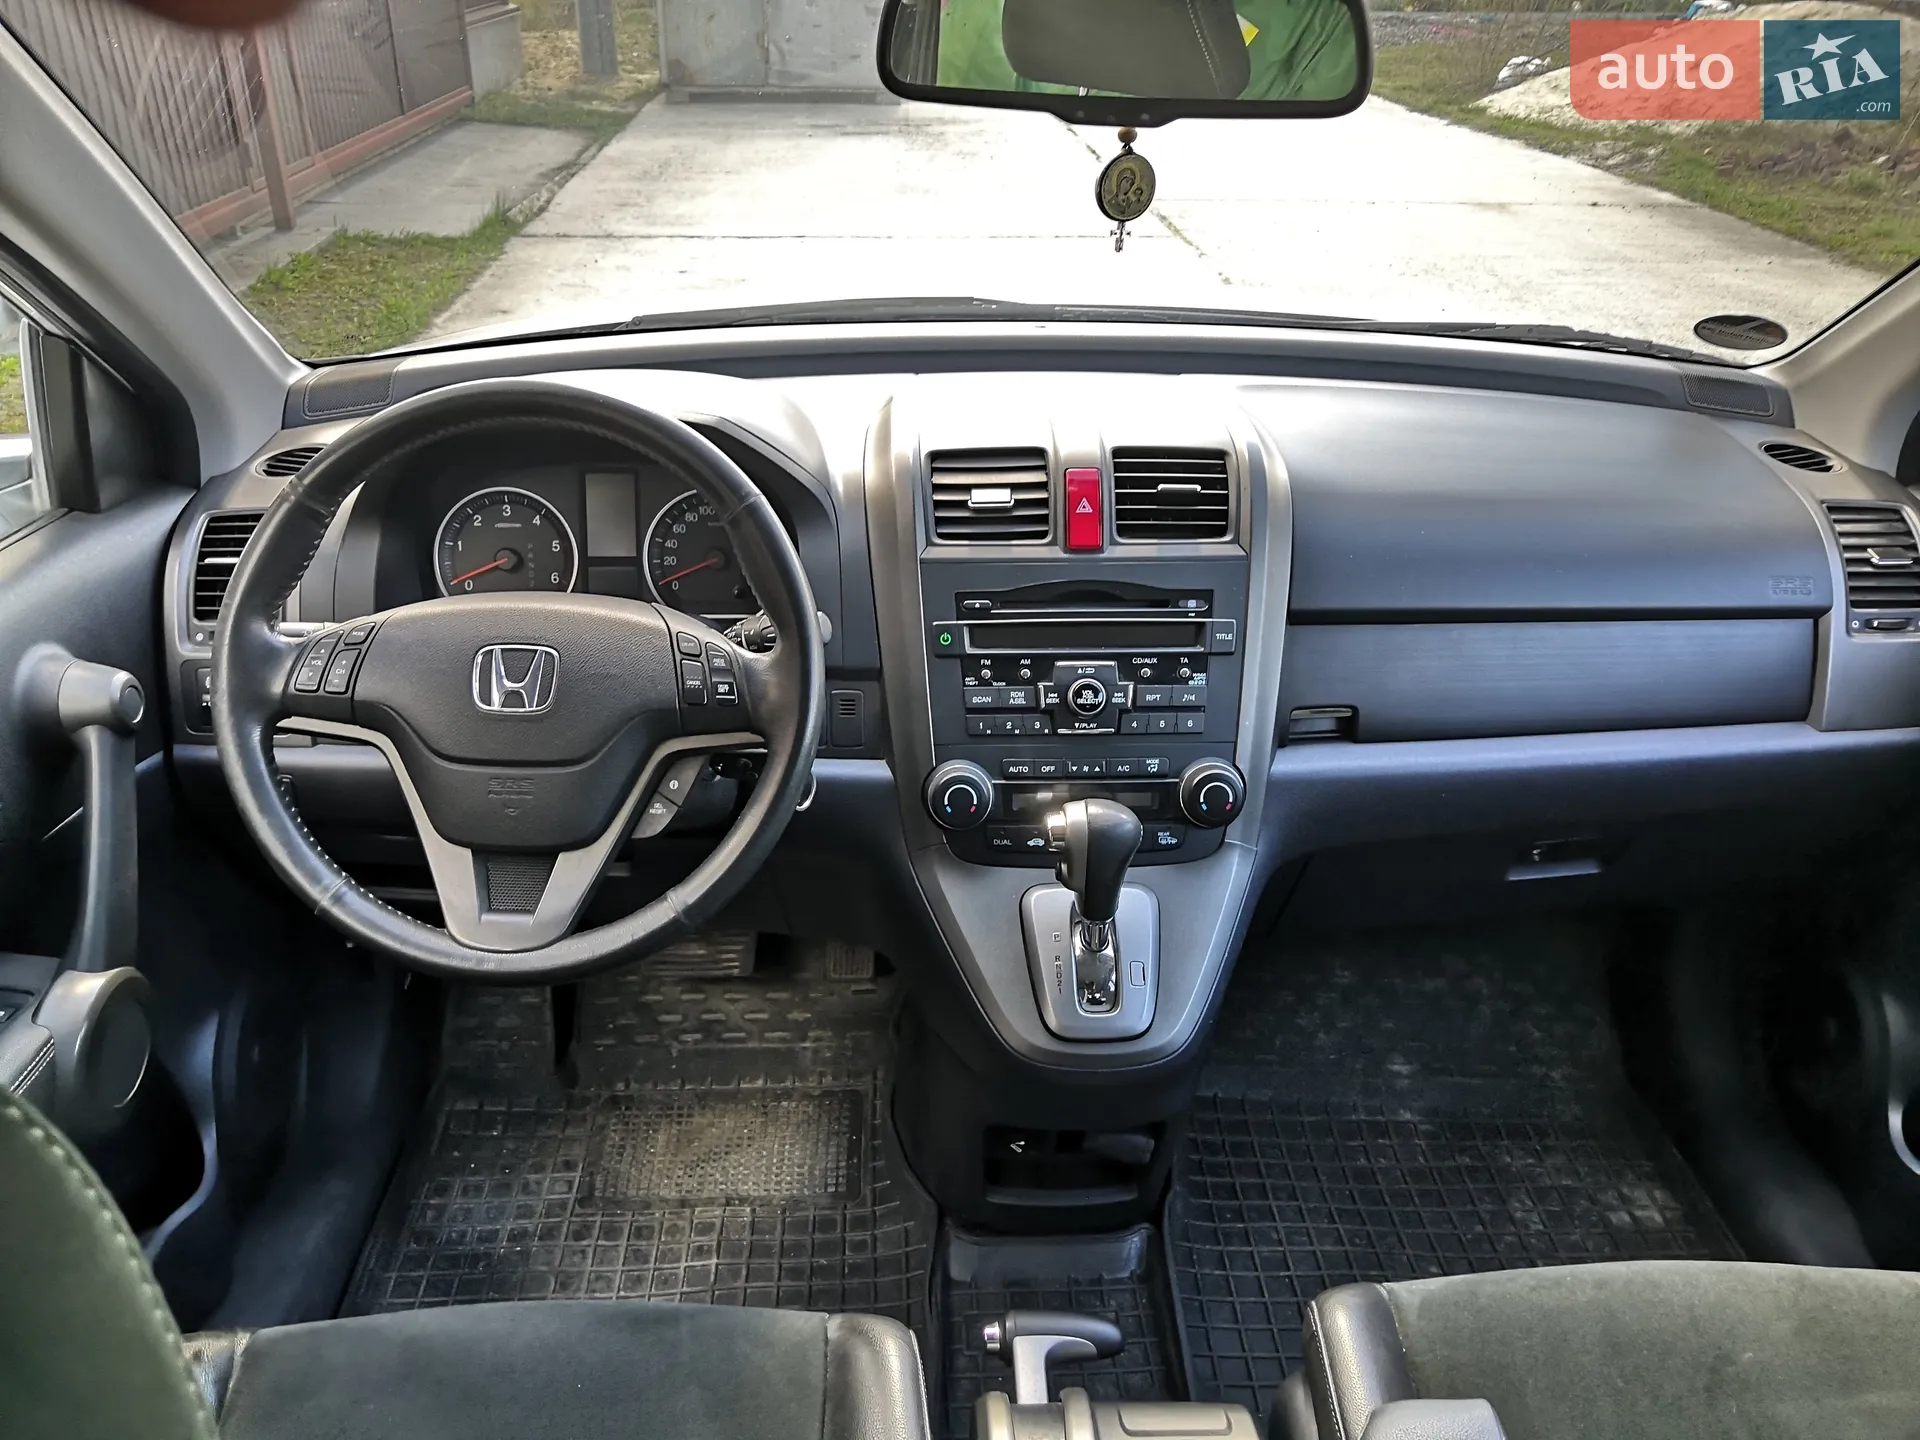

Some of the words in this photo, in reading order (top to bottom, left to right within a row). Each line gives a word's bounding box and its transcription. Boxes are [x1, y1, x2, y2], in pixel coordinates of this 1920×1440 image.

[502, 504, 511, 516] 3
[699, 506, 715, 516] 100
[473, 514, 482, 526] 2
[532, 514, 541, 526] 4
[685, 512, 698, 522] 80
[672, 524, 686, 533] 60
[457, 540, 463, 552] 1
[551, 540, 560, 552] 5
[664, 539, 678, 548] 40
[663, 556, 677, 565] 20
[550, 572, 559, 584] 6
[464, 579, 473, 591] 0
[672, 581, 679, 590] 0
[1034, 721, 1040, 729] 3
[1160, 720, 1165, 728] 5
[1053, 933, 1060, 941] P
[1055, 963, 1062, 971] N
